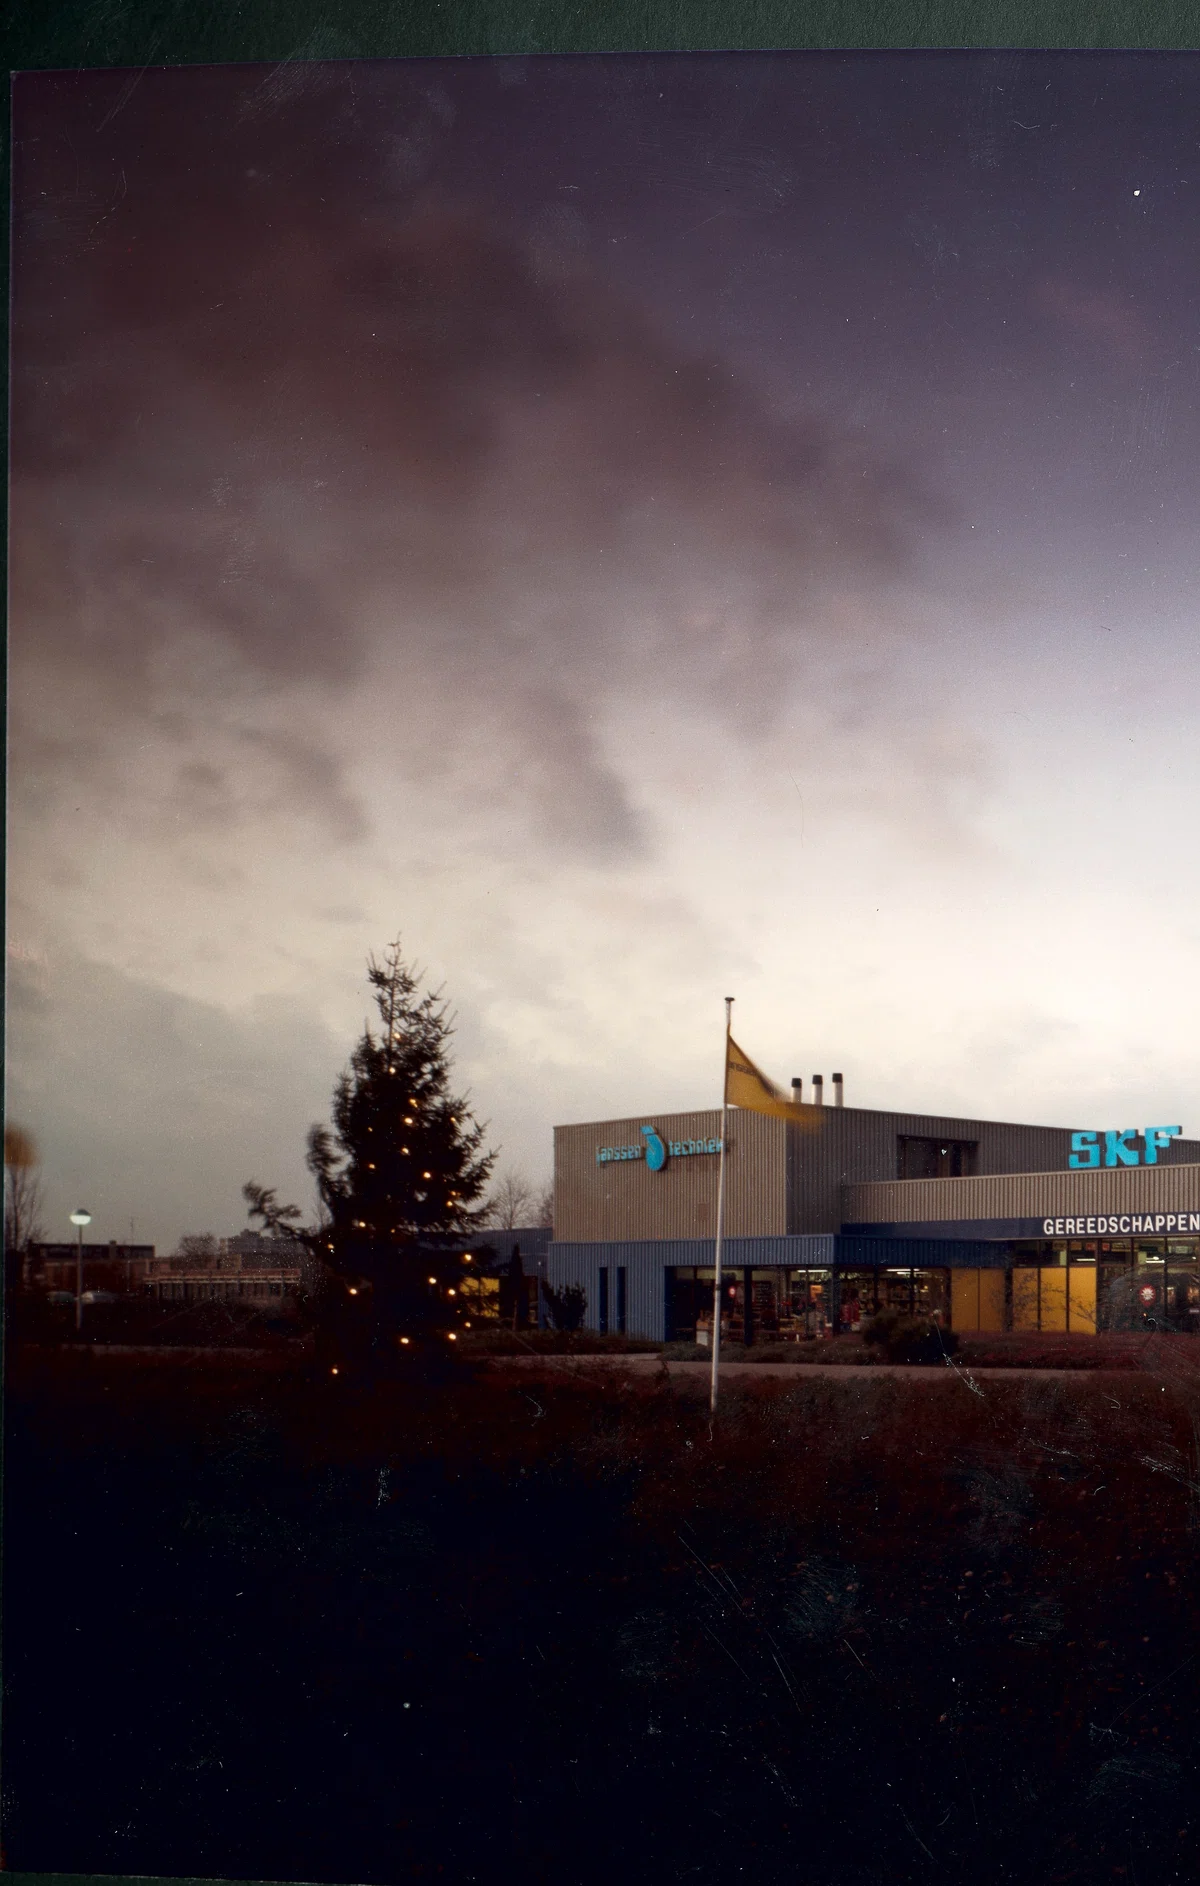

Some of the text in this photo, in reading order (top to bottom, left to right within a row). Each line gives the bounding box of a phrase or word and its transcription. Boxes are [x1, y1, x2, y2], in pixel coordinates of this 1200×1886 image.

[596, 1145, 641, 1168] janssen
[1068, 1125, 1183, 1169] SKF
[1043, 1213, 1200, 1235] GEREEDSCHAPPEN
